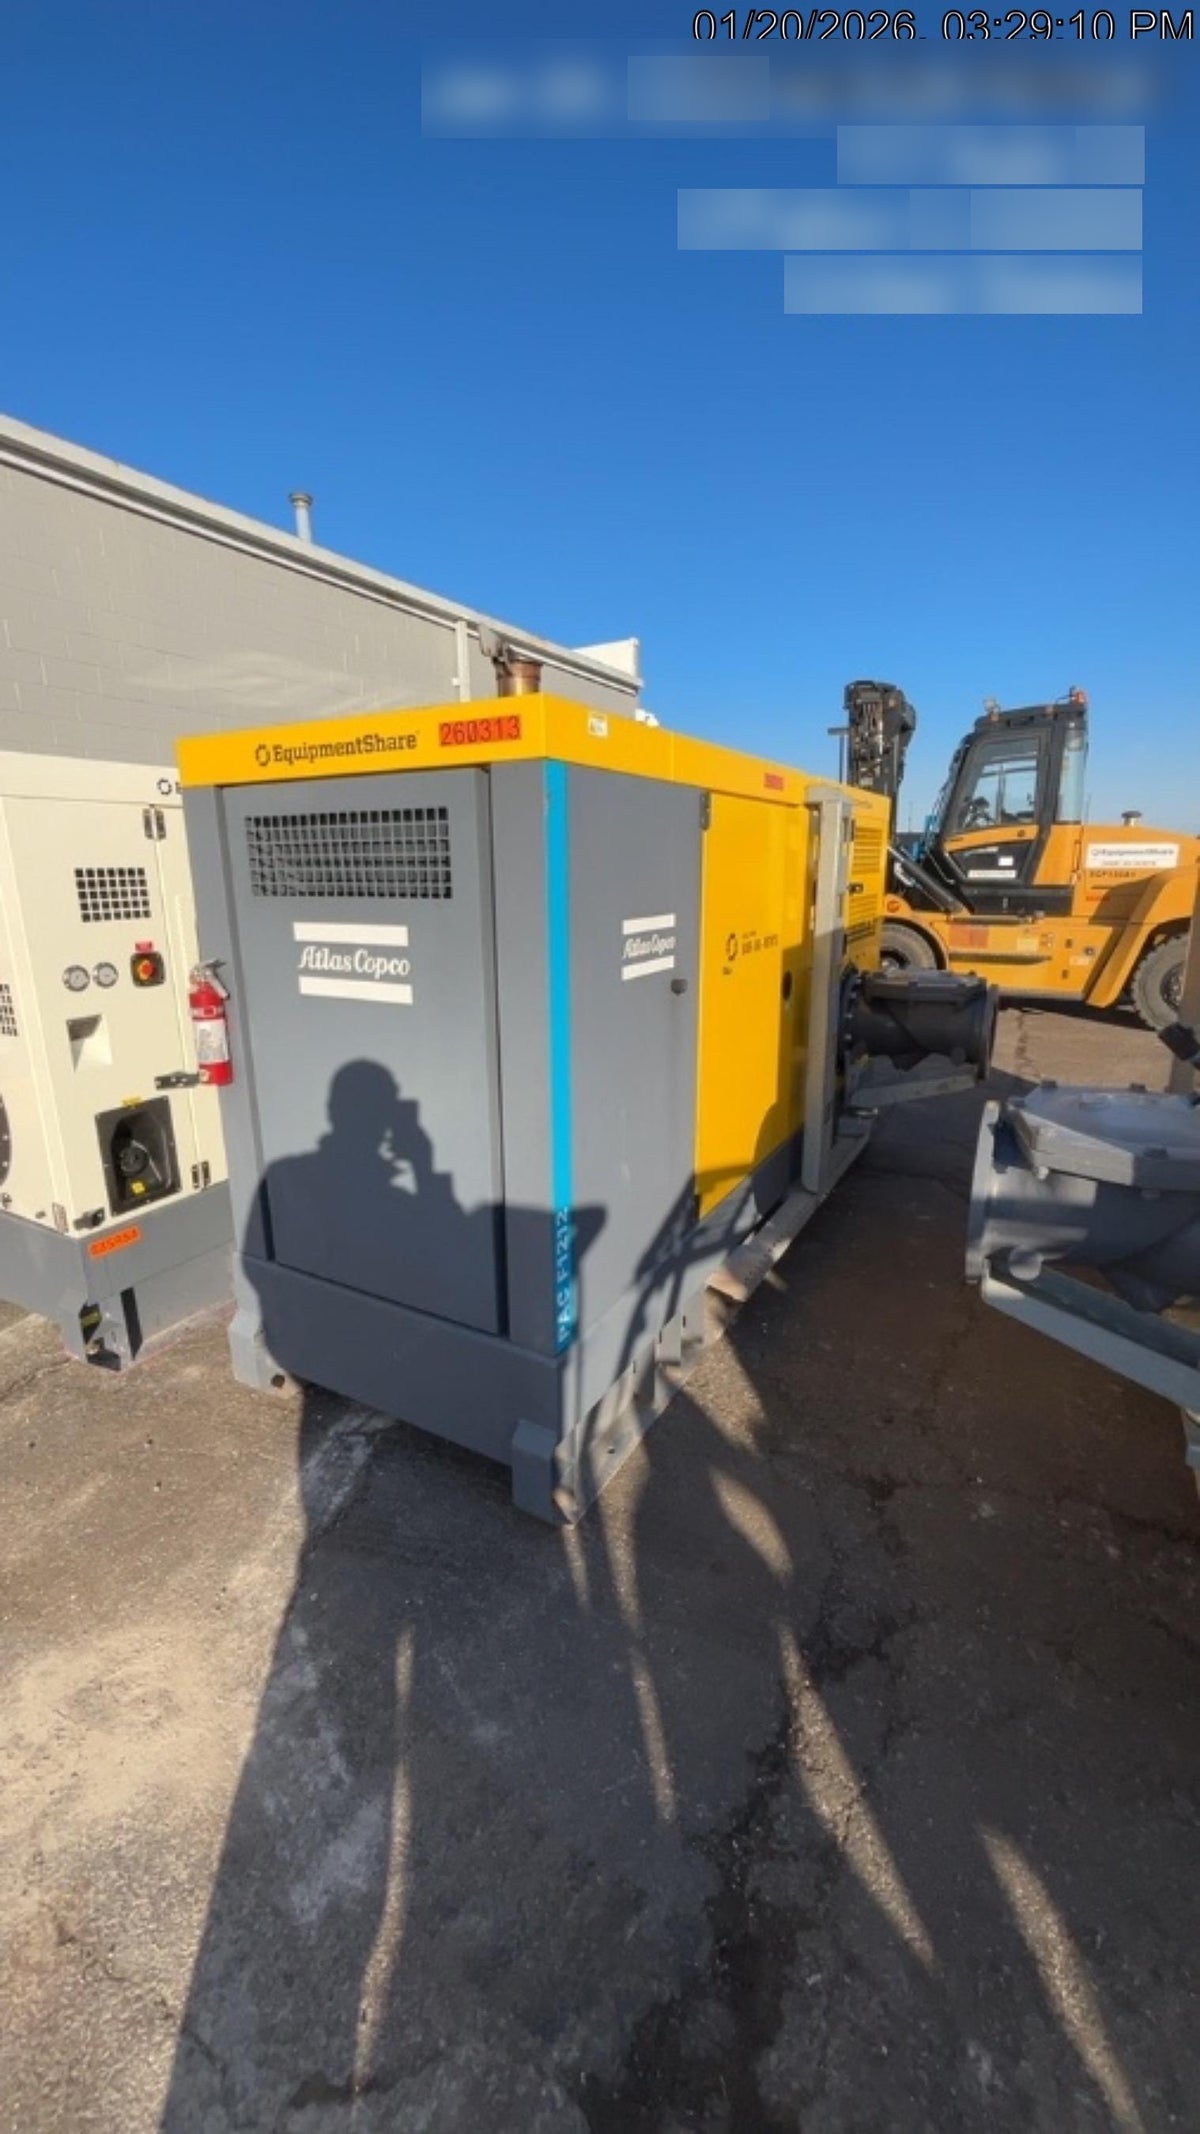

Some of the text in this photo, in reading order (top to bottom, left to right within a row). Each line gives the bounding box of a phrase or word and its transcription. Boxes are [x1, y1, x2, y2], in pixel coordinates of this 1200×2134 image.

[440, 716, 520, 746] 260313
[272, 732, 418, 764] EquipmentShare
[298, 945, 411, 979] Atlas Copco
